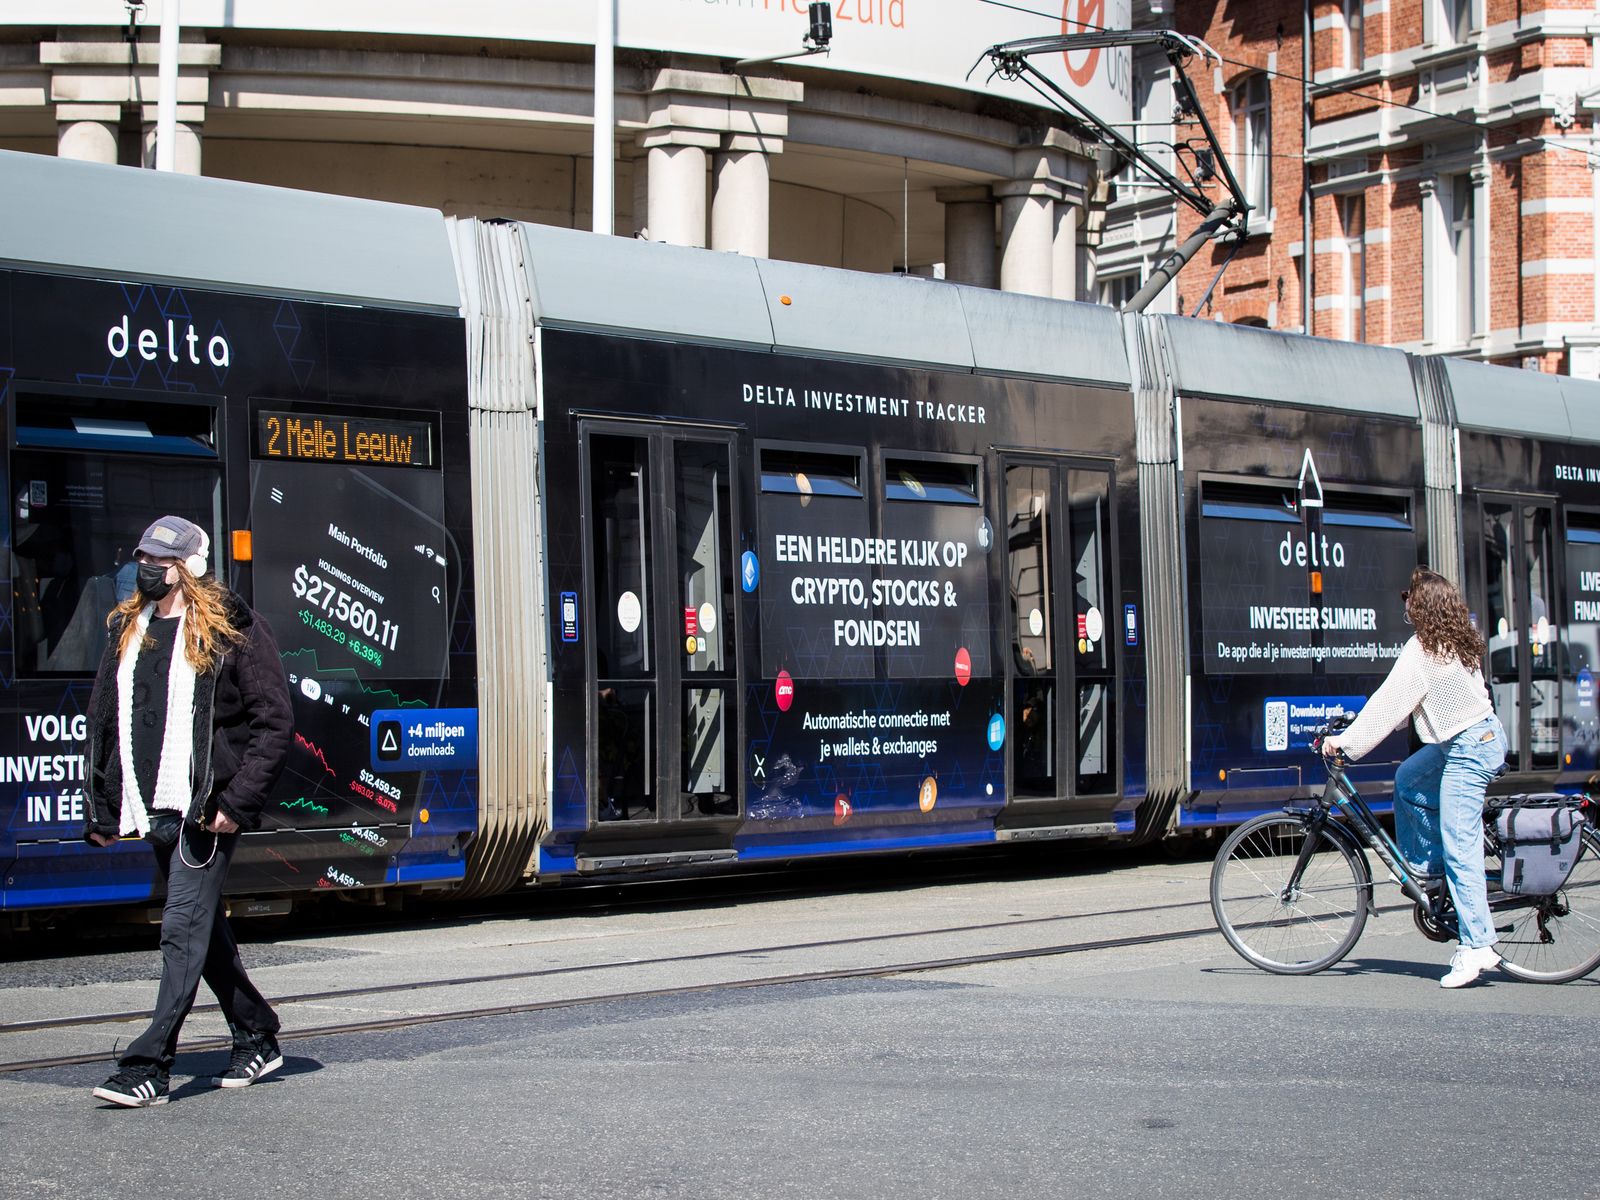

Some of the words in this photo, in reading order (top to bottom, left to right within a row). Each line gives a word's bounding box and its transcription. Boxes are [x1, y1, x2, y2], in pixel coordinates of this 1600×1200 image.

[107, 315, 229, 367] delta
[743, 384, 796, 407] DELTA
[804, 390, 909, 417] INVESTMENT
[916, 401, 986, 424] TRACKER
[267, 417, 281, 455] 2
[287, 419, 336, 459] Melle
[344, 422, 413, 463] Leeuw
[1555, 465, 1583, 482] DELTA
[328, 523, 351, 546] Main
[350, 537, 388, 569] Portfolio
[775, 534, 813, 562] EEN
[817, 536, 898, 565] HELDERE
[901, 540, 941, 567] KIJK
[942, 541, 968, 568] OP
[1279, 531, 1345, 567] delta
[318, 559, 352, 585] HOLDINGS
[351, 579, 385, 605] OVERVIEW
[791, 576, 869, 609] CRYPTO,
[872, 579, 940, 607] STOCKS
[943, 580, 958, 608] &
[292, 564, 400, 651] $27,560.11
[1250, 606, 1320, 630] INVESTEER
[1321, 607, 1377, 631] SLIMMER
[298, 609, 347, 645] +$1,483.29
[348, 638, 383, 667] +6.39%
[834, 619, 921, 647] FONDSEN
[1218, 641, 1231, 659] De
[1232, 645, 1248, 663] app
[1249, 641, 1263, 659] die
[1263, 641, 1271, 659] al
[1271, 642, 1280, 663] je
[1280, 643, 1331, 663] investeringen
[1332, 642, 1379, 662] overzichtelijk
[324, 693, 334, 706] 1M
[342, 704, 351, 716] 1Y
[1290, 704, 1325, 718] Download
[1326, 704, 1344, 719] gratis
[25, 714, 87, 741] VOLG
[357, 713, 370, 727] ALL
[408, 724, 424, 738] +4
[425, 722, 465, 742] miljoen
[802, 710, 877, 730] Automatische
[878, 710, 929, 728] connectie
[930, 710, 951, 727] met
[408, 743, 455, 757] downloads
[820, 739, 831, 762] je
[833, 737, 870, 756] wallets
[872, 738, 881, 755] &
[883, 736, 937, 759] exchanges
[359, 769, 401, 800] $12,459.23
[27, 796, 51, 823] IN
[57, 788, 84, 822] ÉÉ
